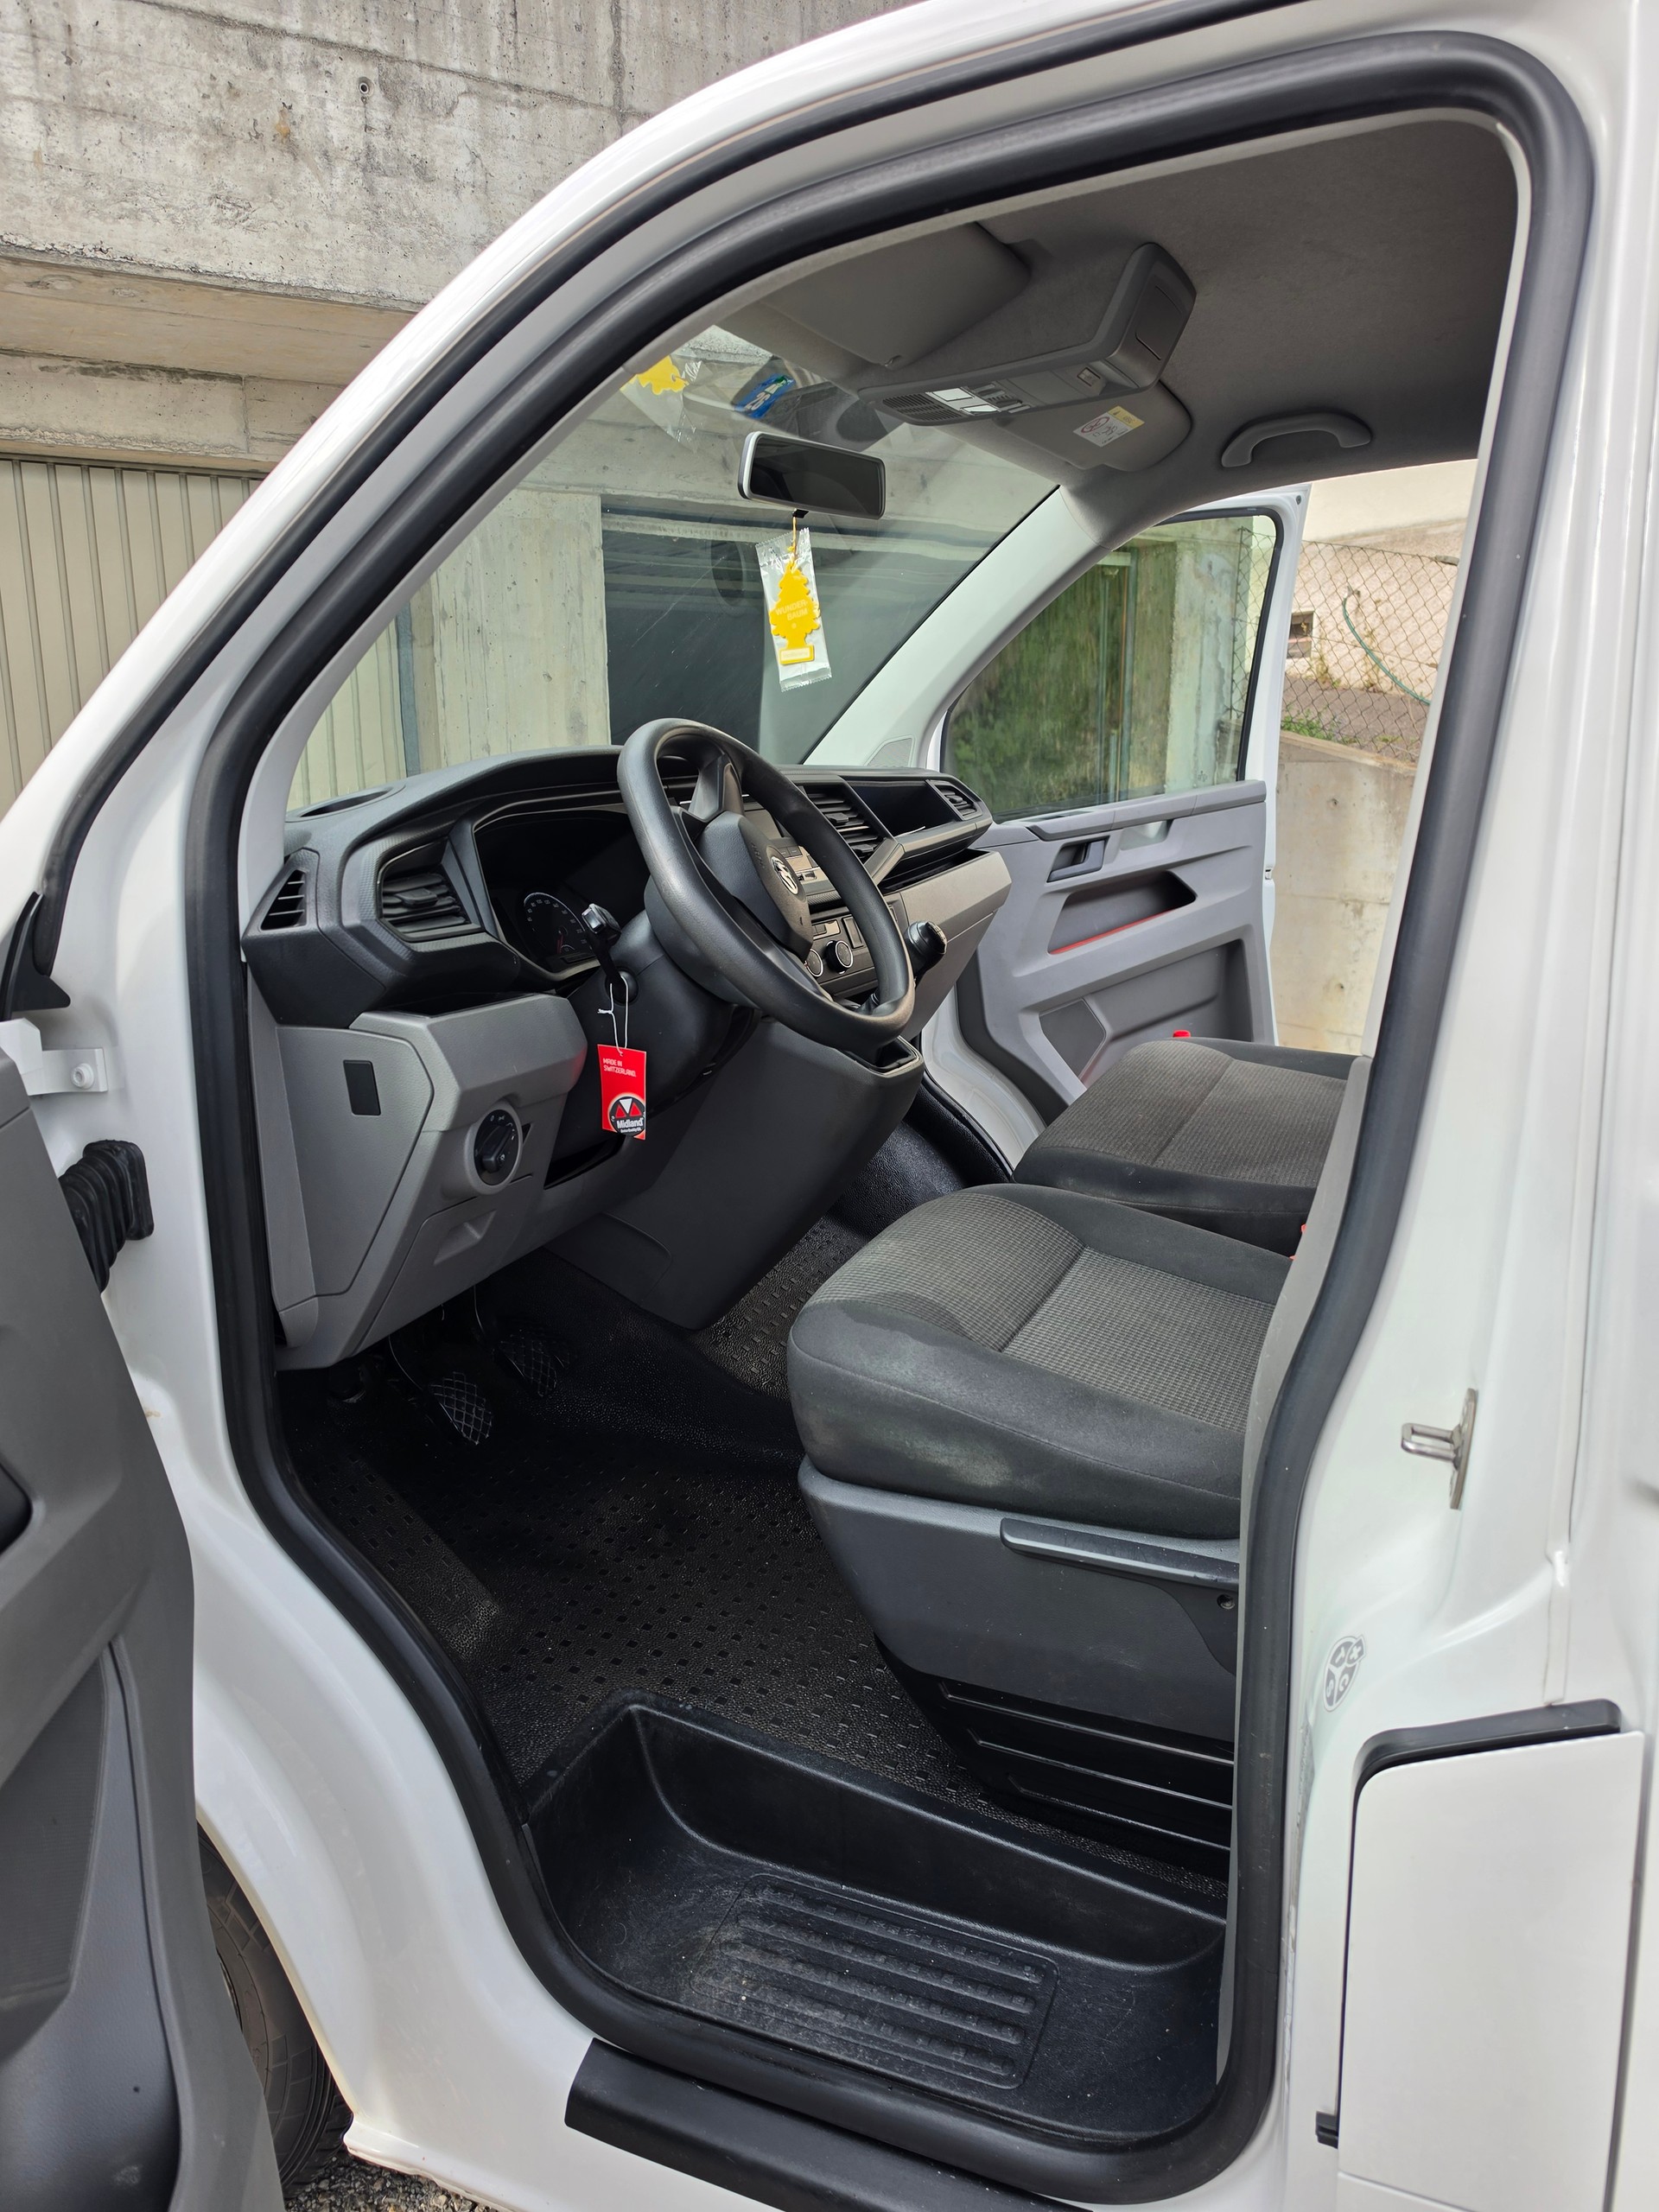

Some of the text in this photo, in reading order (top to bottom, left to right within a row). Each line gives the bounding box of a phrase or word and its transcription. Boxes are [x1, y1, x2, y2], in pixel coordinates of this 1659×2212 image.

[775, 599, 808, 615] WUNDER-
[787, 607, 808, 620] BAUM
[602, 1058, 617, 1066] MADE
[616, 1118, 644, 1129] Midland
